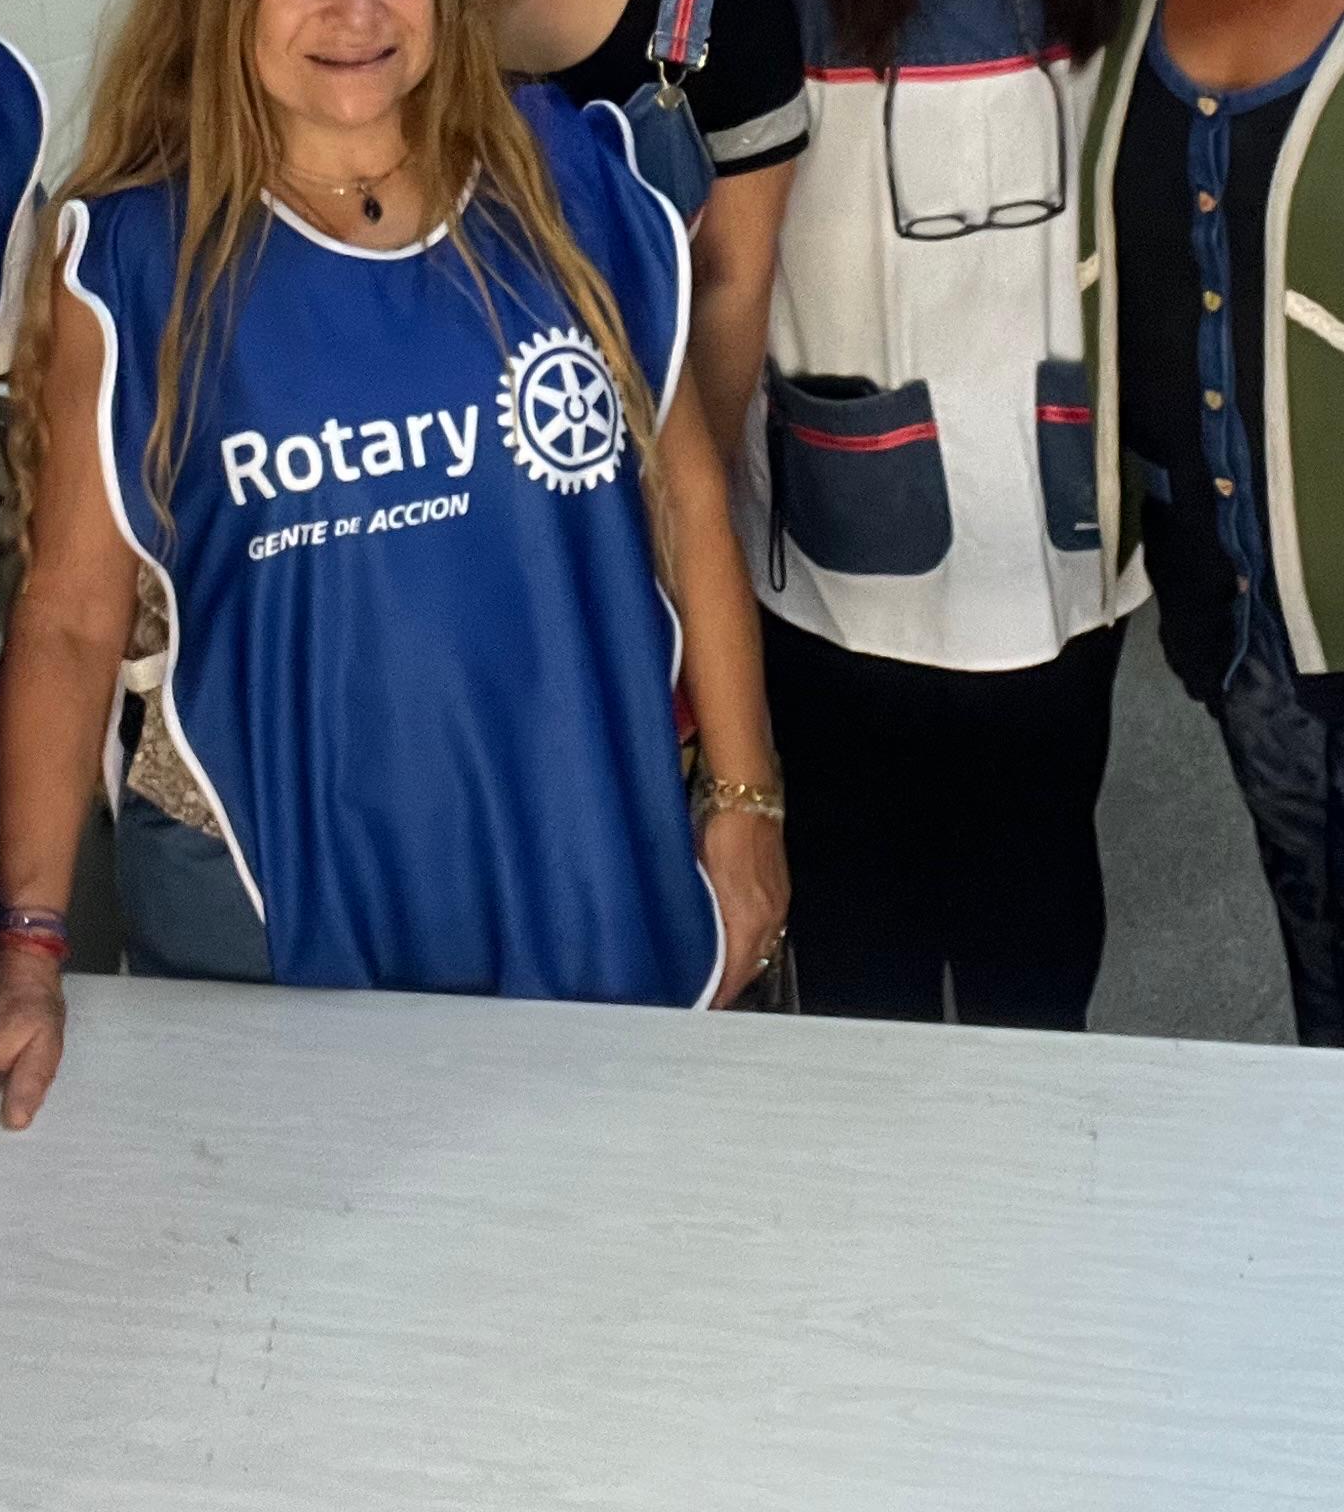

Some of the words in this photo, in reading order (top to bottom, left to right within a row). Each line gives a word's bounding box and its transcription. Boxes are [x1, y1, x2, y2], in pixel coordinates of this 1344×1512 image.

[219, 403, 480, 507] Rotary
[248, 519, 329, 561] GENTE
[334, 516, 360, 539] DE
[367, 492, 471, 536] ACCION
